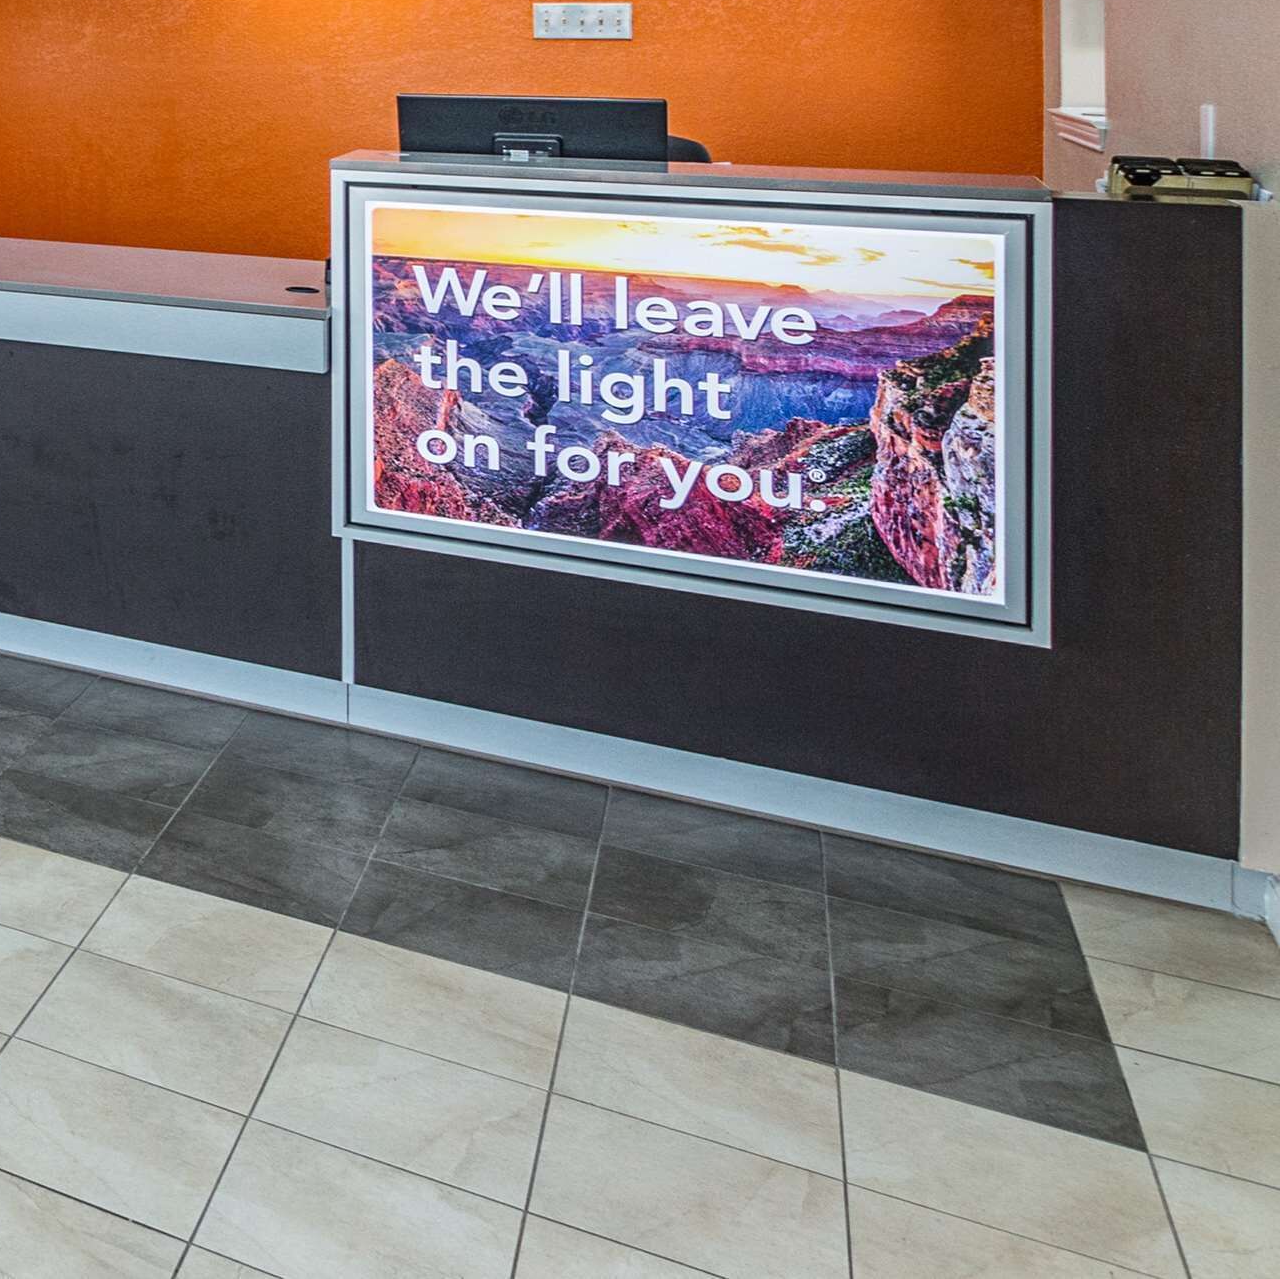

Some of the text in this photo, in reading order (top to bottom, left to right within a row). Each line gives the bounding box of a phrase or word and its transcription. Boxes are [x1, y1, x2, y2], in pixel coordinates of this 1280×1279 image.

[412, 265, 817, 344] We'll leave
[414, 339, 731, 424] the light
[416, 429, 500, 471] on
[527, 425, 635, 486] for
